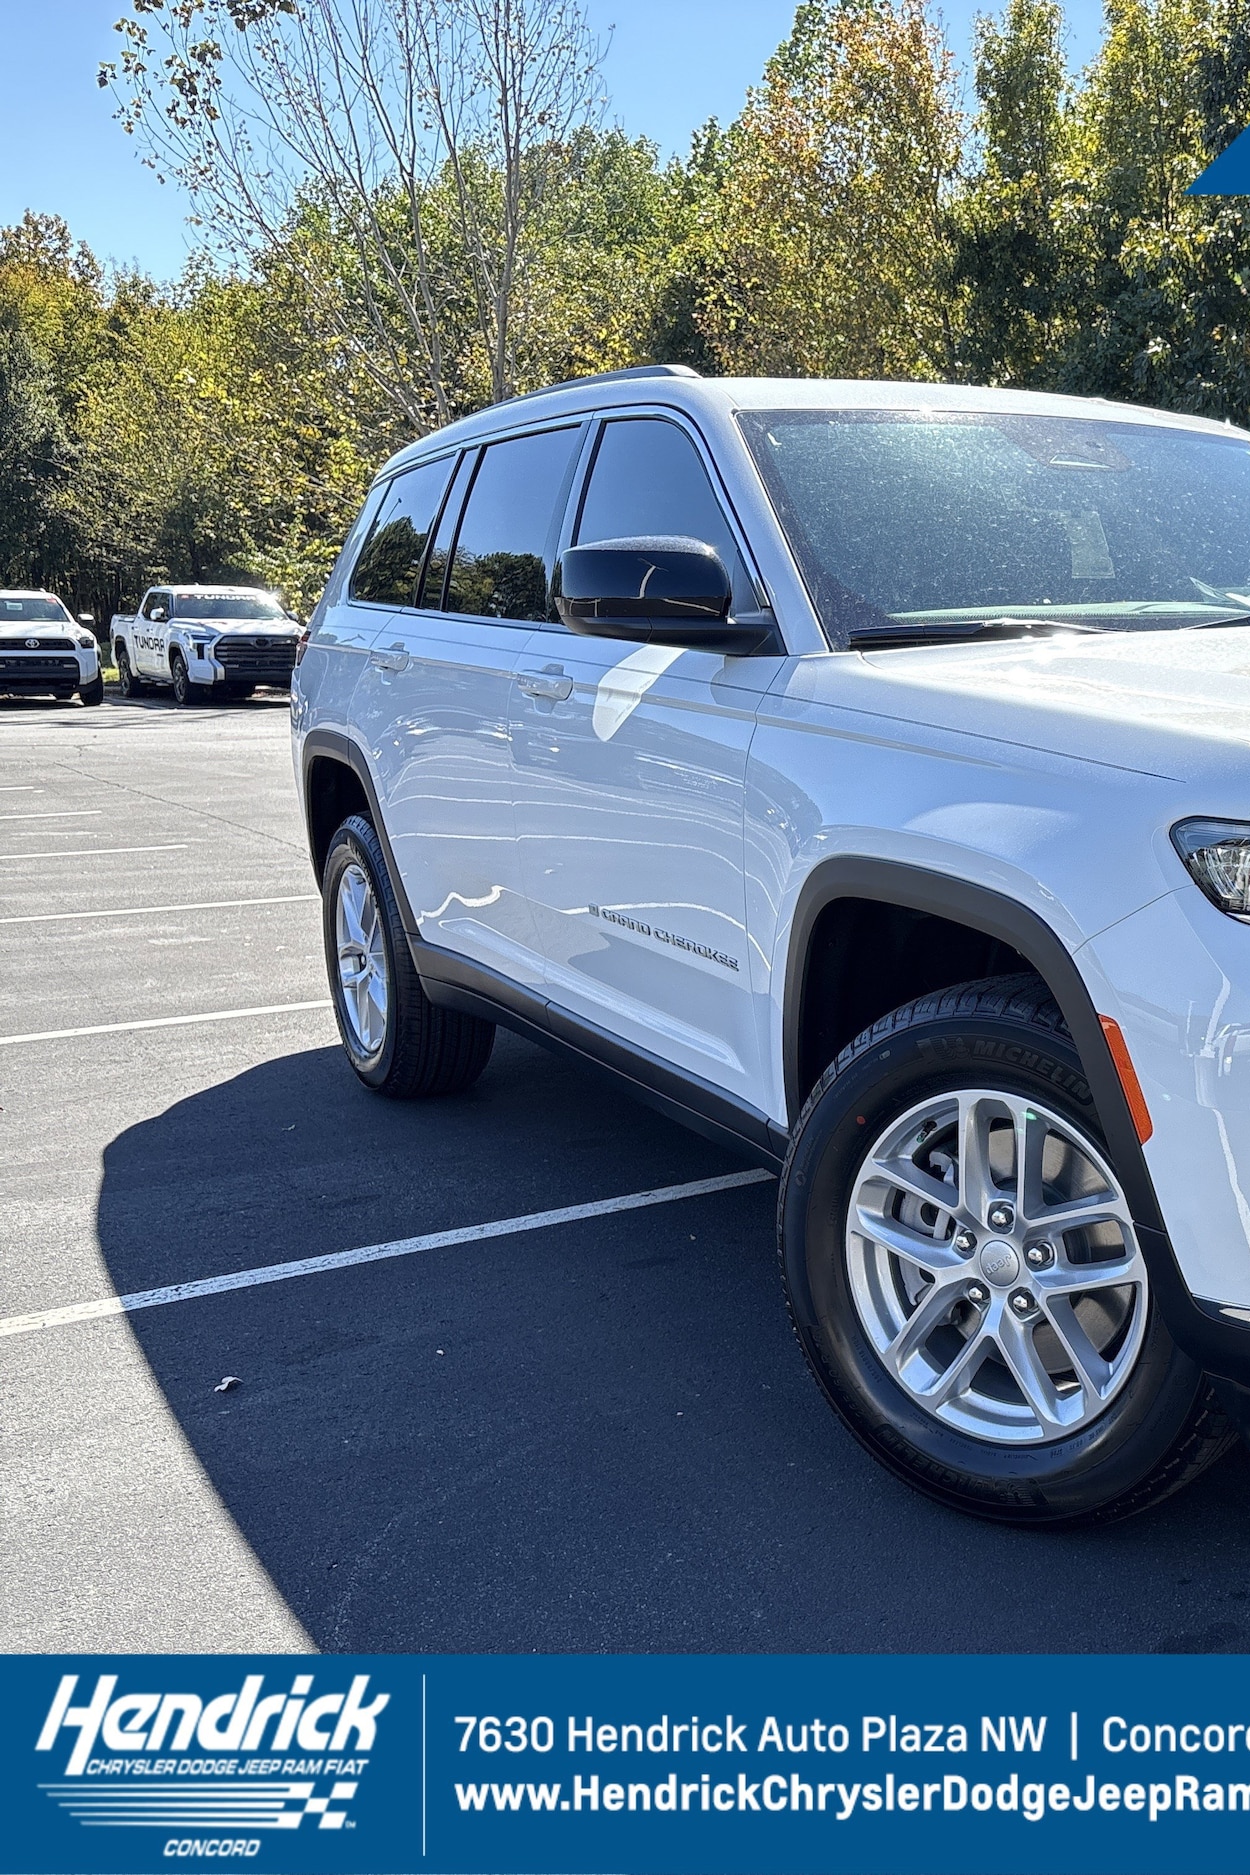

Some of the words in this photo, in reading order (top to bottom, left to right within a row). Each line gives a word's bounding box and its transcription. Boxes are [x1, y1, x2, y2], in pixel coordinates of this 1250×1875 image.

[133, 635, 165, 652] TUNDRA
[601, 908, 652, 937] GRAND
[653, 927, 740, 972] CHEROKEE
[972, 1039, 1092, 1099] MICHELIN
[985, 1254, 1012, 1275] Jeep
